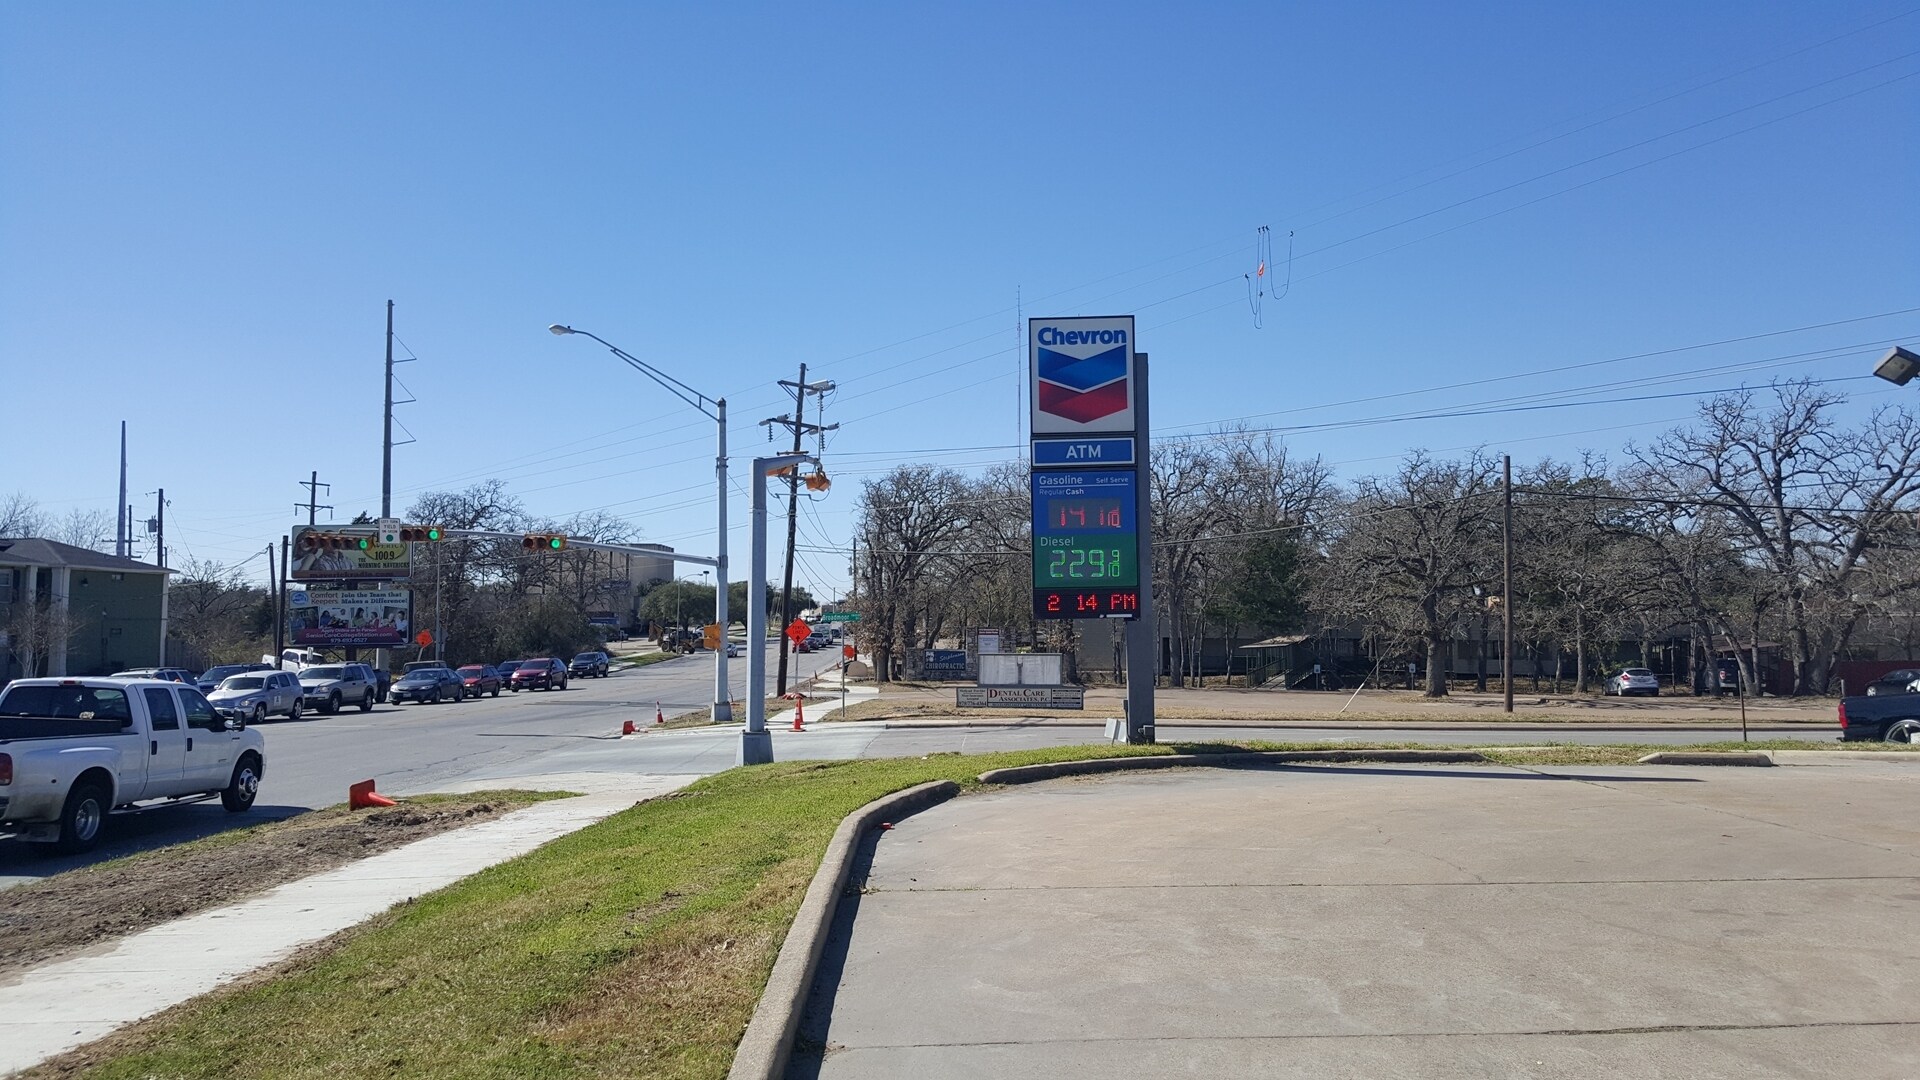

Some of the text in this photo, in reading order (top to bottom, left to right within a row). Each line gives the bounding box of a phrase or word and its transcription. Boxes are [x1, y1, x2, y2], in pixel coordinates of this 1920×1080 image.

[1038, 327, 1127, 345] Chevron
[1066, 445, 1101, 459] ATM
[1039, 475, 1083, 485] Gasoline
[1040, 537, 1074, 547] Diesel
[1110, 594, 1136, 610] PM
[989, 689, 1045, 698] DENTAL CARE
